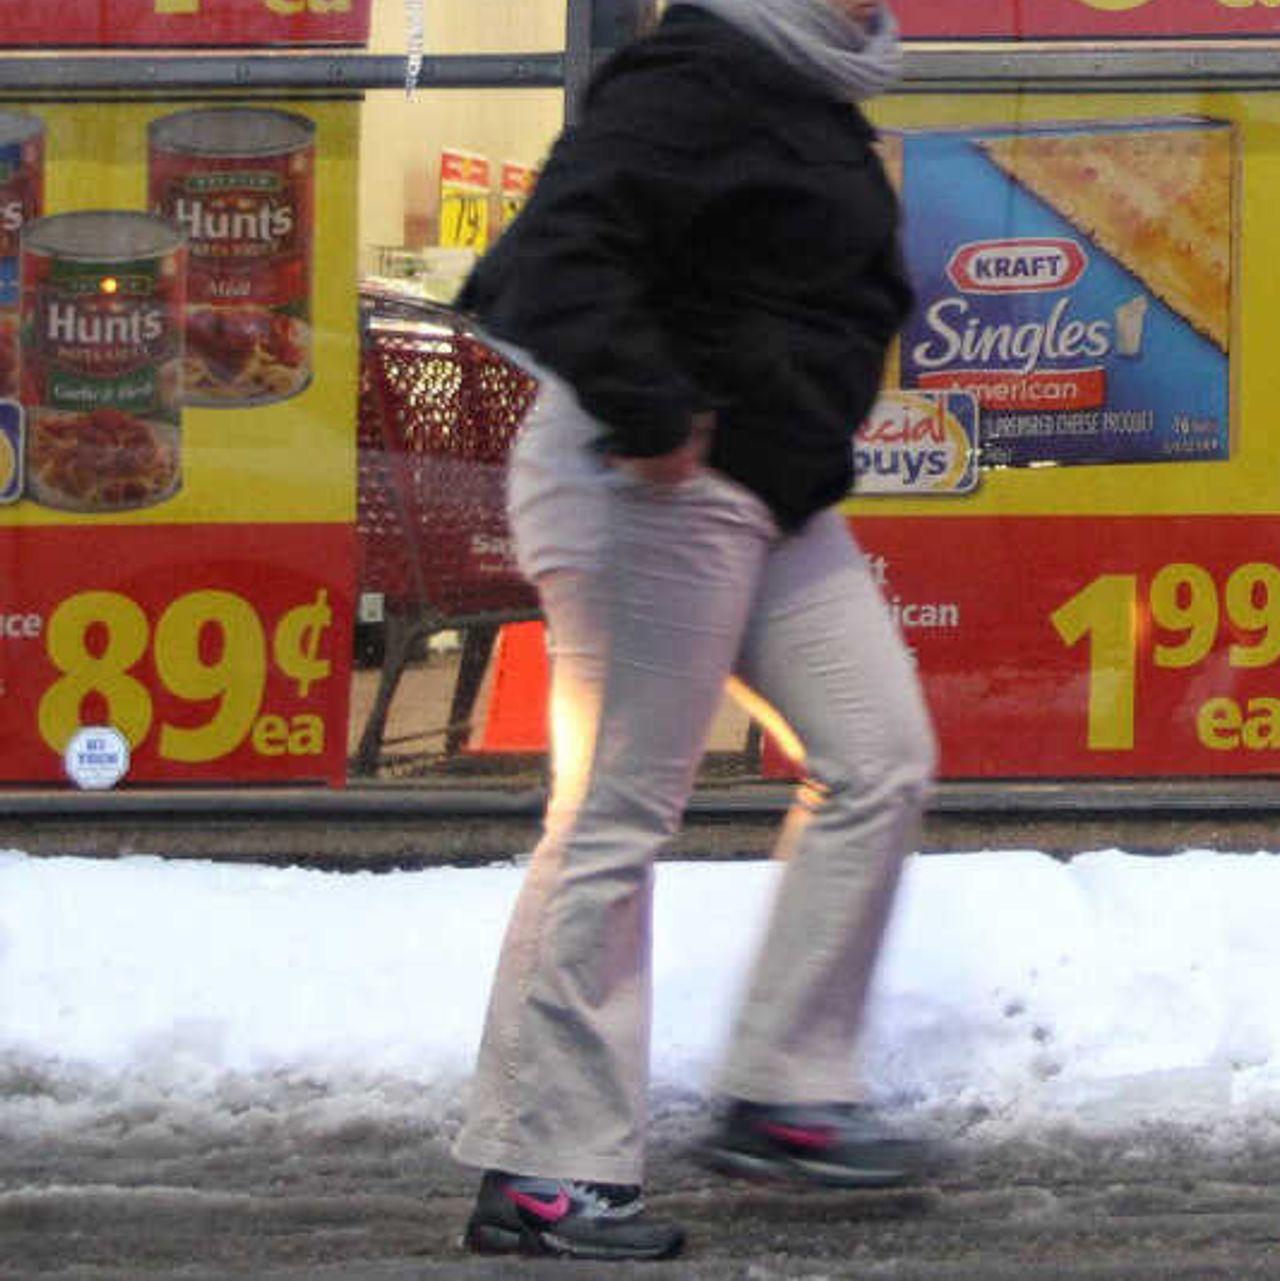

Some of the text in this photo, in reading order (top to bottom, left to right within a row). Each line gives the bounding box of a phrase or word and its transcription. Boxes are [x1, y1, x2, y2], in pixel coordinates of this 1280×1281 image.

[974, 254, 1061, 279] KRAFT
[913, 296, 1113, 374] Singles
[250, 708, 324, 755] ea
